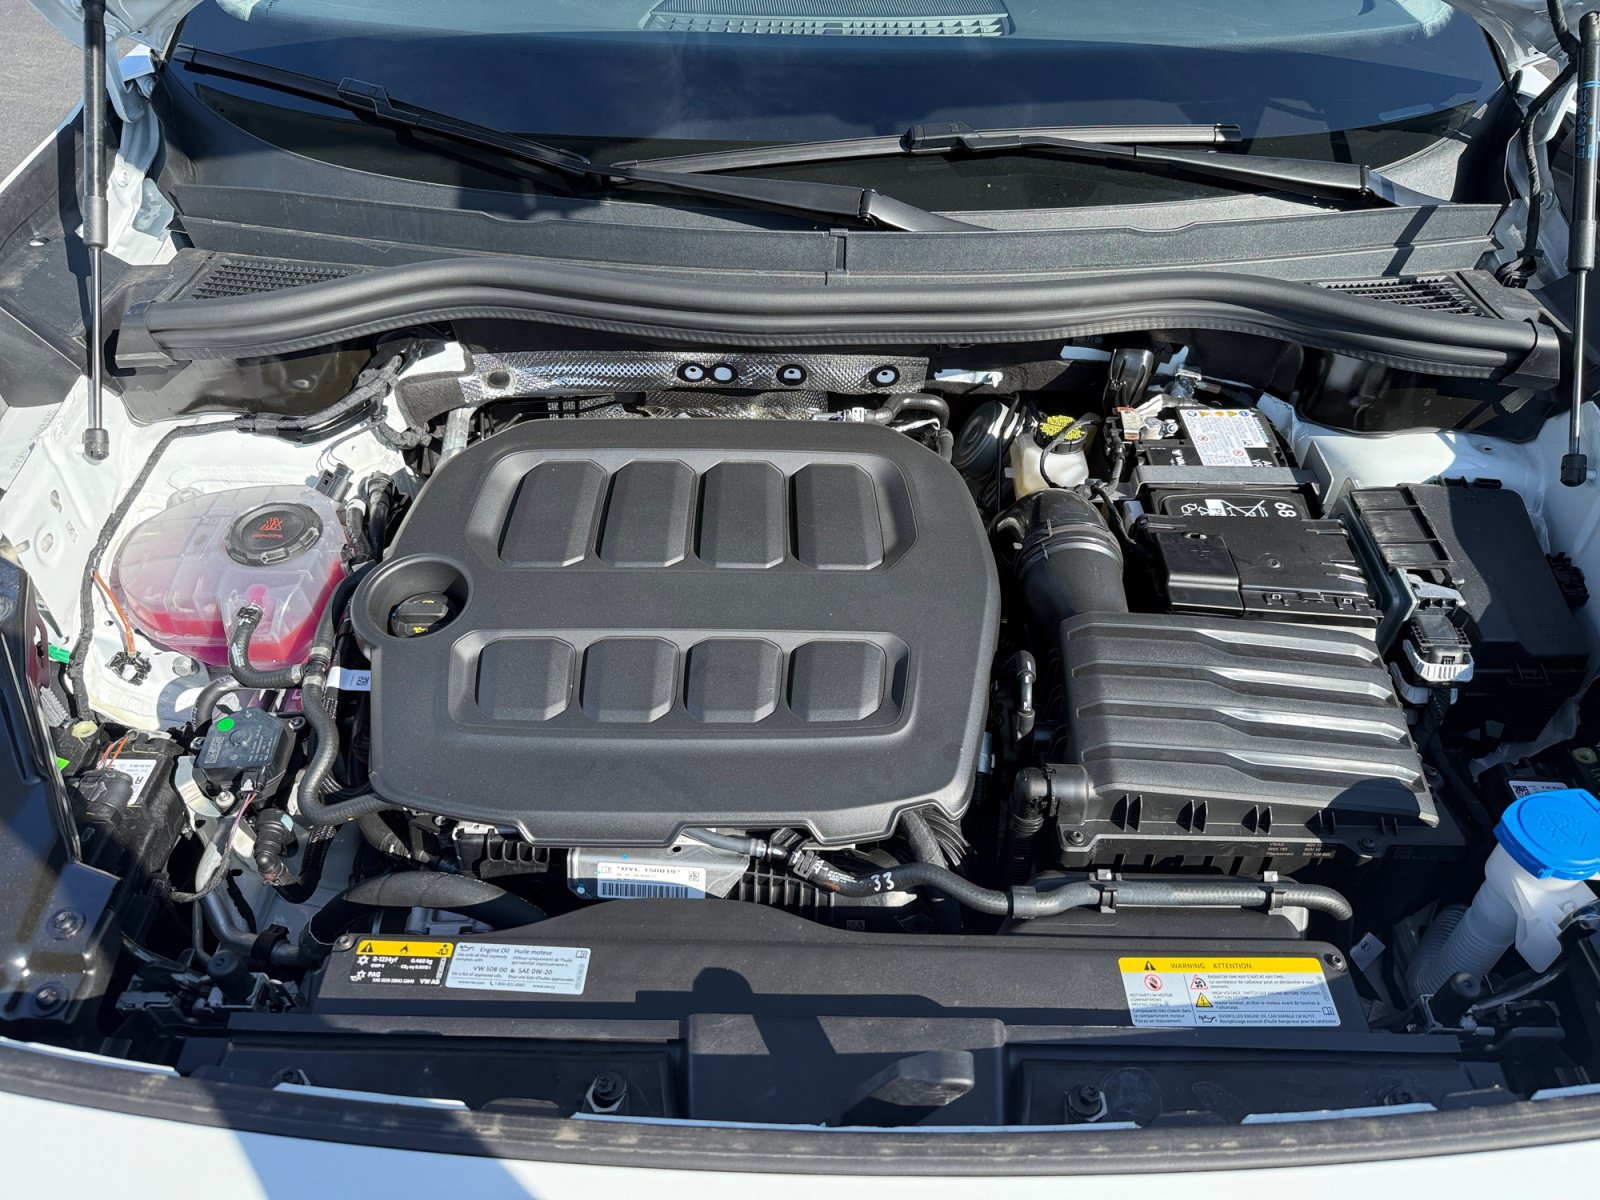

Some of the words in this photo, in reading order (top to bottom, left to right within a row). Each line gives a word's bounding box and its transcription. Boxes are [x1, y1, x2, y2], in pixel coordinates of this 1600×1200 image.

[1274, 502, 1297, 518] 68
[870, 871, 894, 892] 33
[372, 956, 399, 964] R-1234yf
